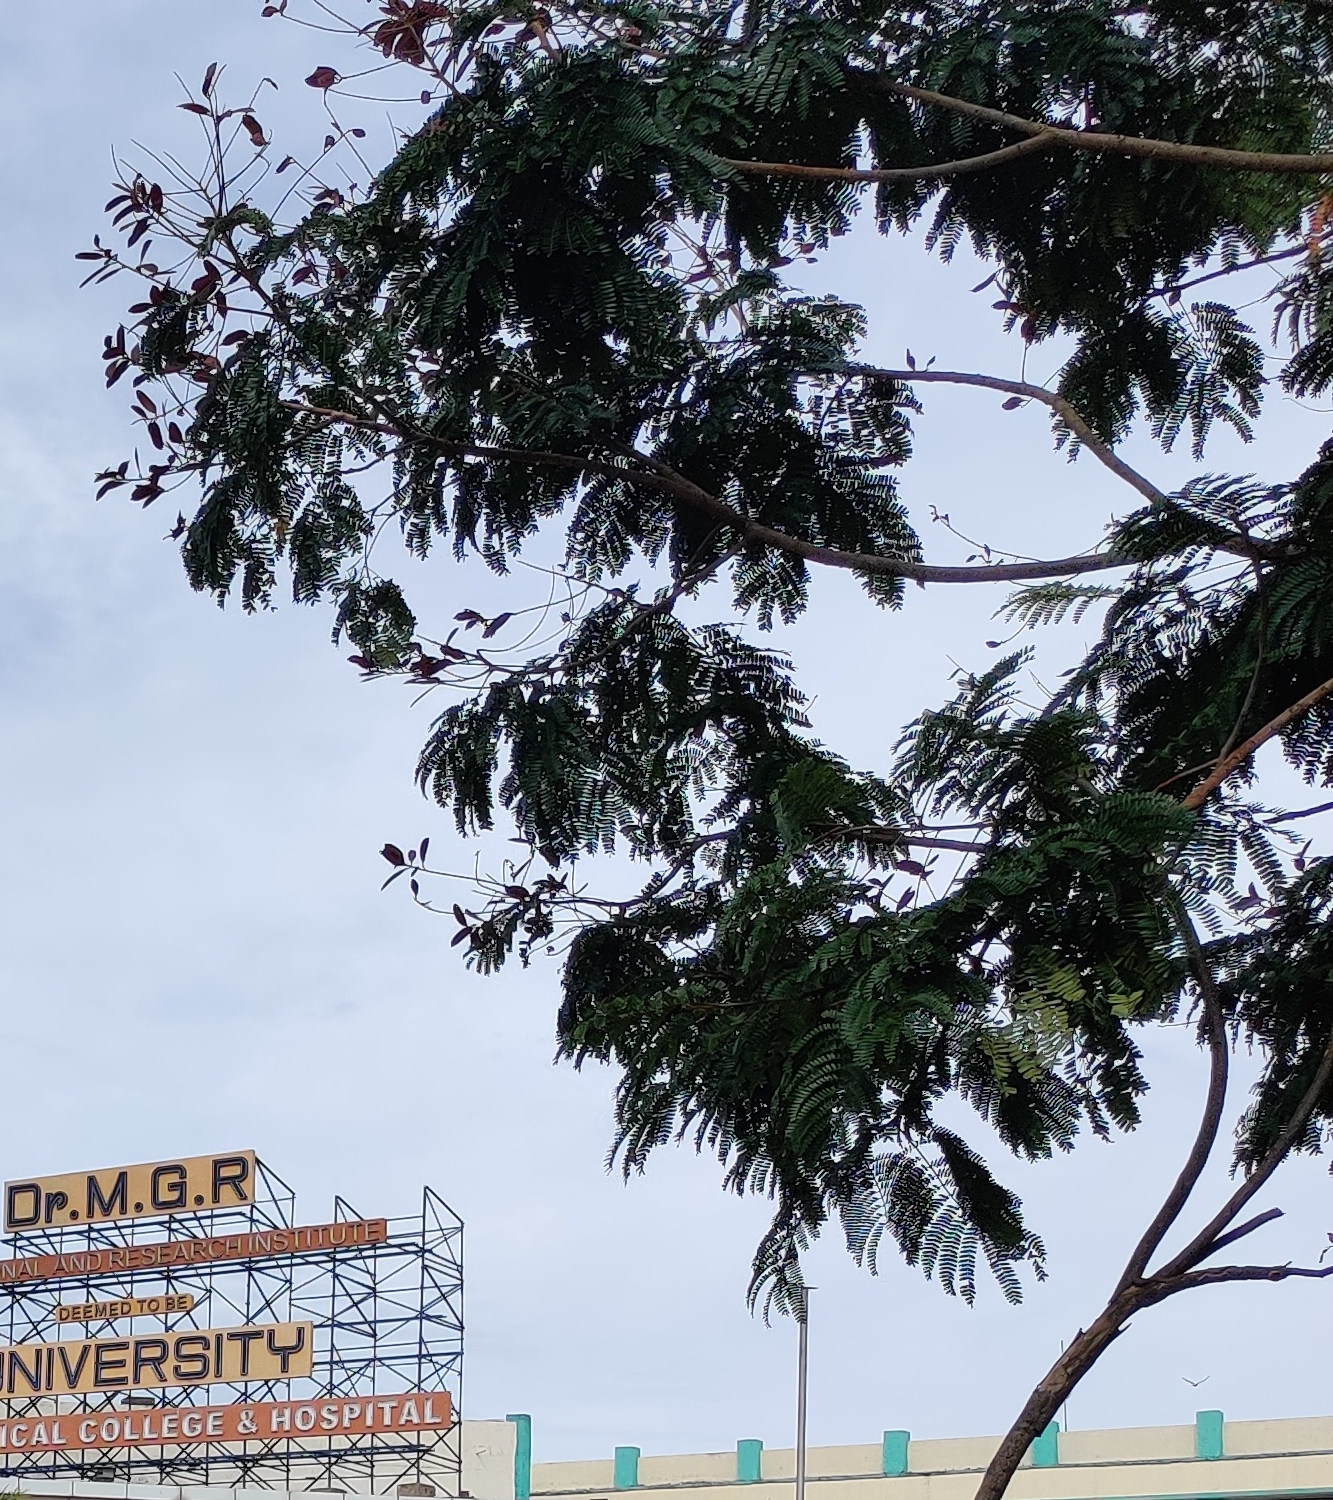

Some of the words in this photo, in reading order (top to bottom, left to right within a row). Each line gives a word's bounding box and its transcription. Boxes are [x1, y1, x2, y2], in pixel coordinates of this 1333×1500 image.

[6, 1156, 250, 1229] Dr.M.G.R
[52, 1251, 102, 1276] AND
[108, 1236, 243, 1269] RESEARCH
[247, 1221, 382, 1254] INSTITUTE
[59, 1301, 132, 1321] DEEMED
[137, 1298, 160, 1313] TO
[164, 1296, 189, 1311] BE
[77, 1409, 225, 1444] COLLEGE
[235, 1408, 259, 1435] &
[269, 1396, 444, 1433] HOSPITAL
